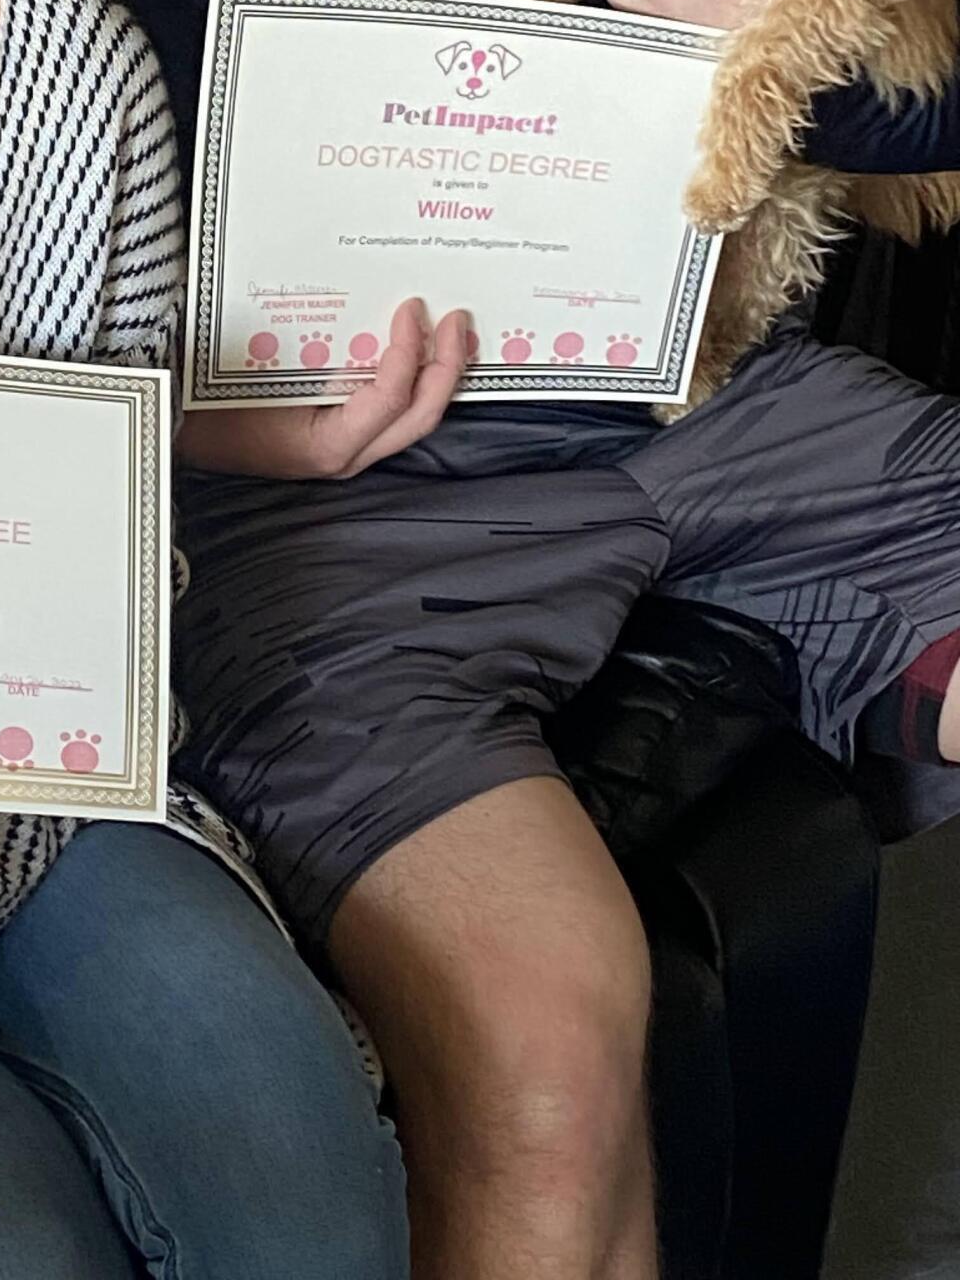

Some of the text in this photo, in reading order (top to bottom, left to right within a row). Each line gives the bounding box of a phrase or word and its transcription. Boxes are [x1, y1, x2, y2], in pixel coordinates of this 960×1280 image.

[382, 102, 558, 135] PetImpact!
[317, 144, 611, 182] DOGTASTIC DEGREE
[432, 179, 489, 191] is given to
[417, 200, 494, 221] Willow
[338, 235, 356, 246] For
[358, 235, 419, 248] Completion
[421, 236, 432, 246] of
[522, 240, 570, 253] Program
[260, 300, 305, 310] JENNIFER
[270, 313, 337, 324] DOG TRAINER
[7, 684, 40, 697] DATE
